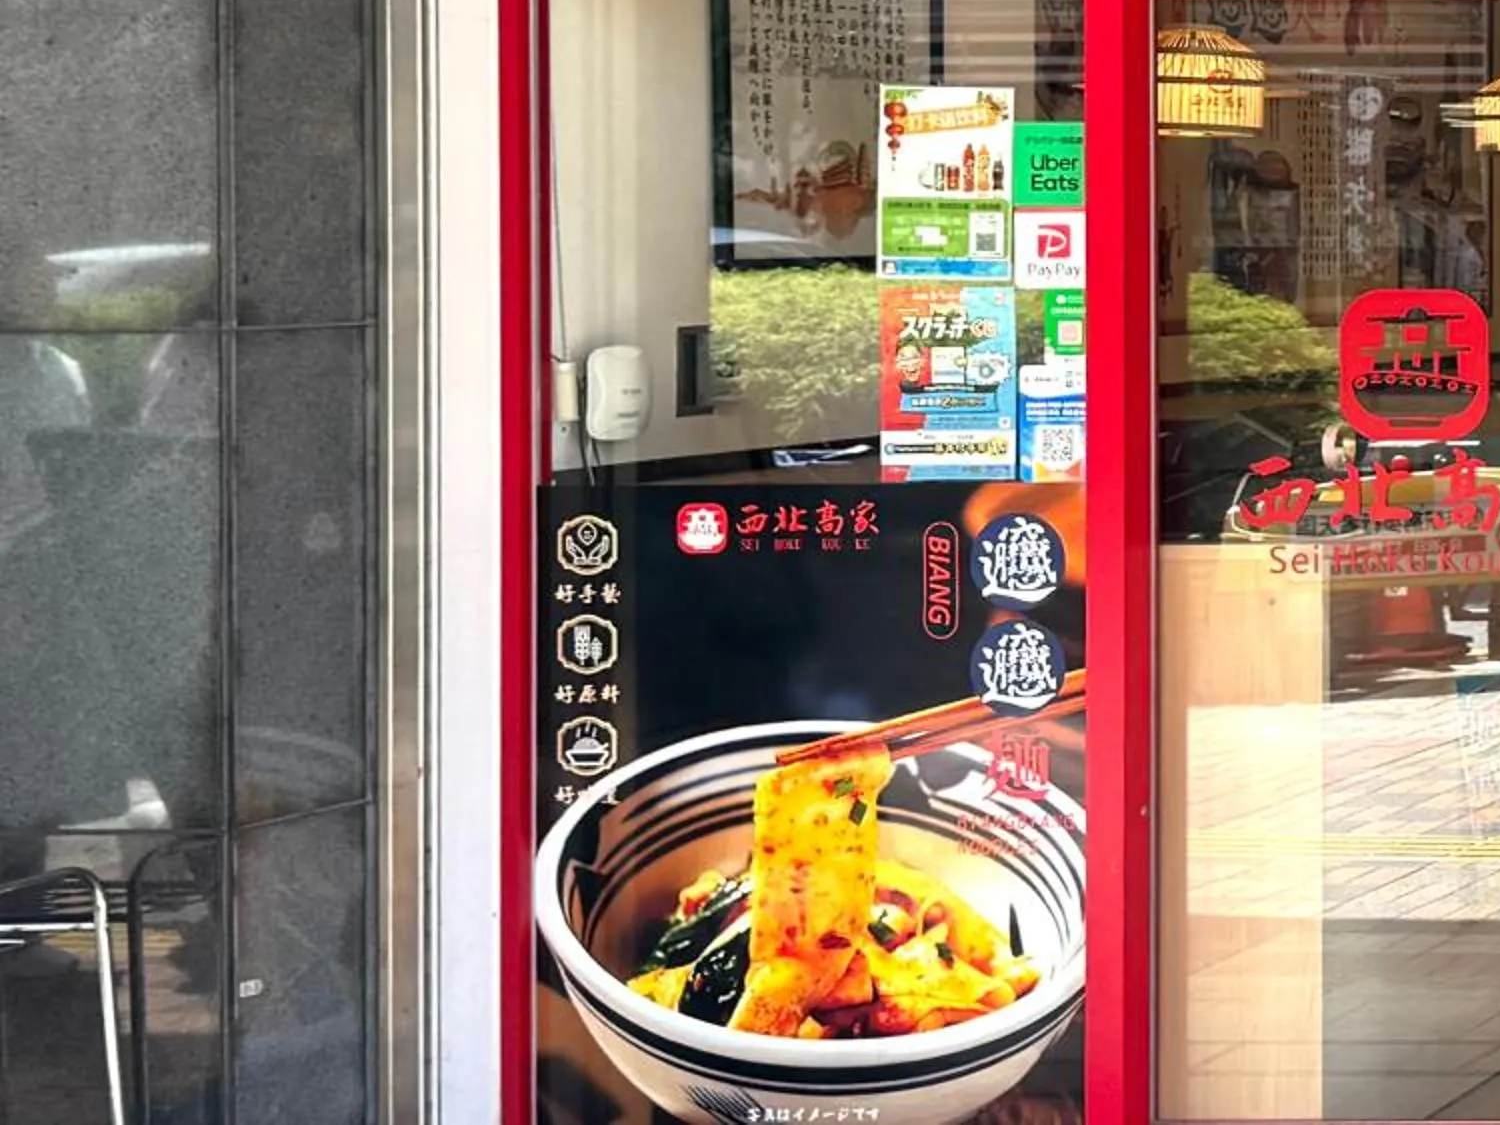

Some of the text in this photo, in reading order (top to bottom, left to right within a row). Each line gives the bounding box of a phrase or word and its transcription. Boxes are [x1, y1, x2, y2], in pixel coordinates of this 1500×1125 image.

[1030, 155, 1080, 172] Uber
[1031, 174, 1080, 192] Eats
[1027, 263, 1082, 280] PayPay
[736, 499, 880, 536] 西北高家
[1269, 545, 1321, 573] Sei
[928, 535, 951, 626] BIANG
